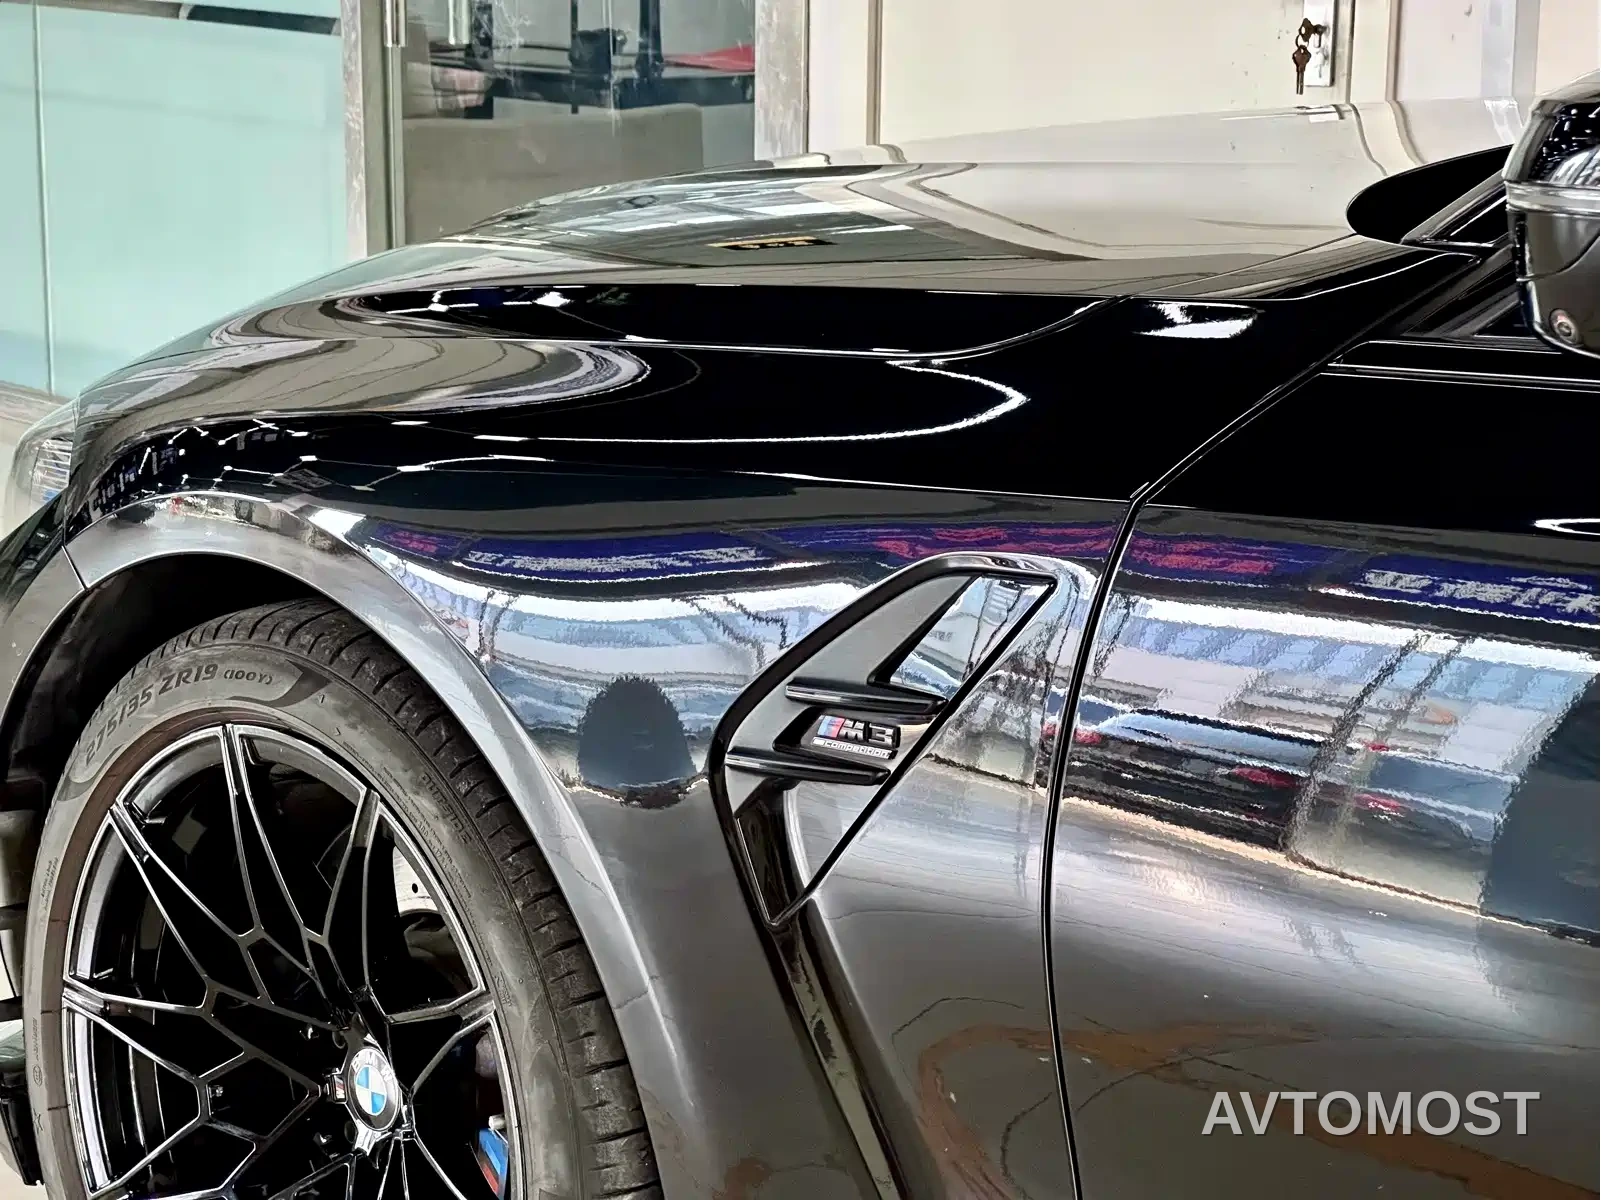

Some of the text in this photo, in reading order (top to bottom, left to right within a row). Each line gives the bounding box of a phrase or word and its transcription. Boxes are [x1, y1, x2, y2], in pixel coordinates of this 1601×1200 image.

[85, 664, 273, 766] 275/35 ZR19 (100Y)
[350, 1050, 393, 1081] BMW
